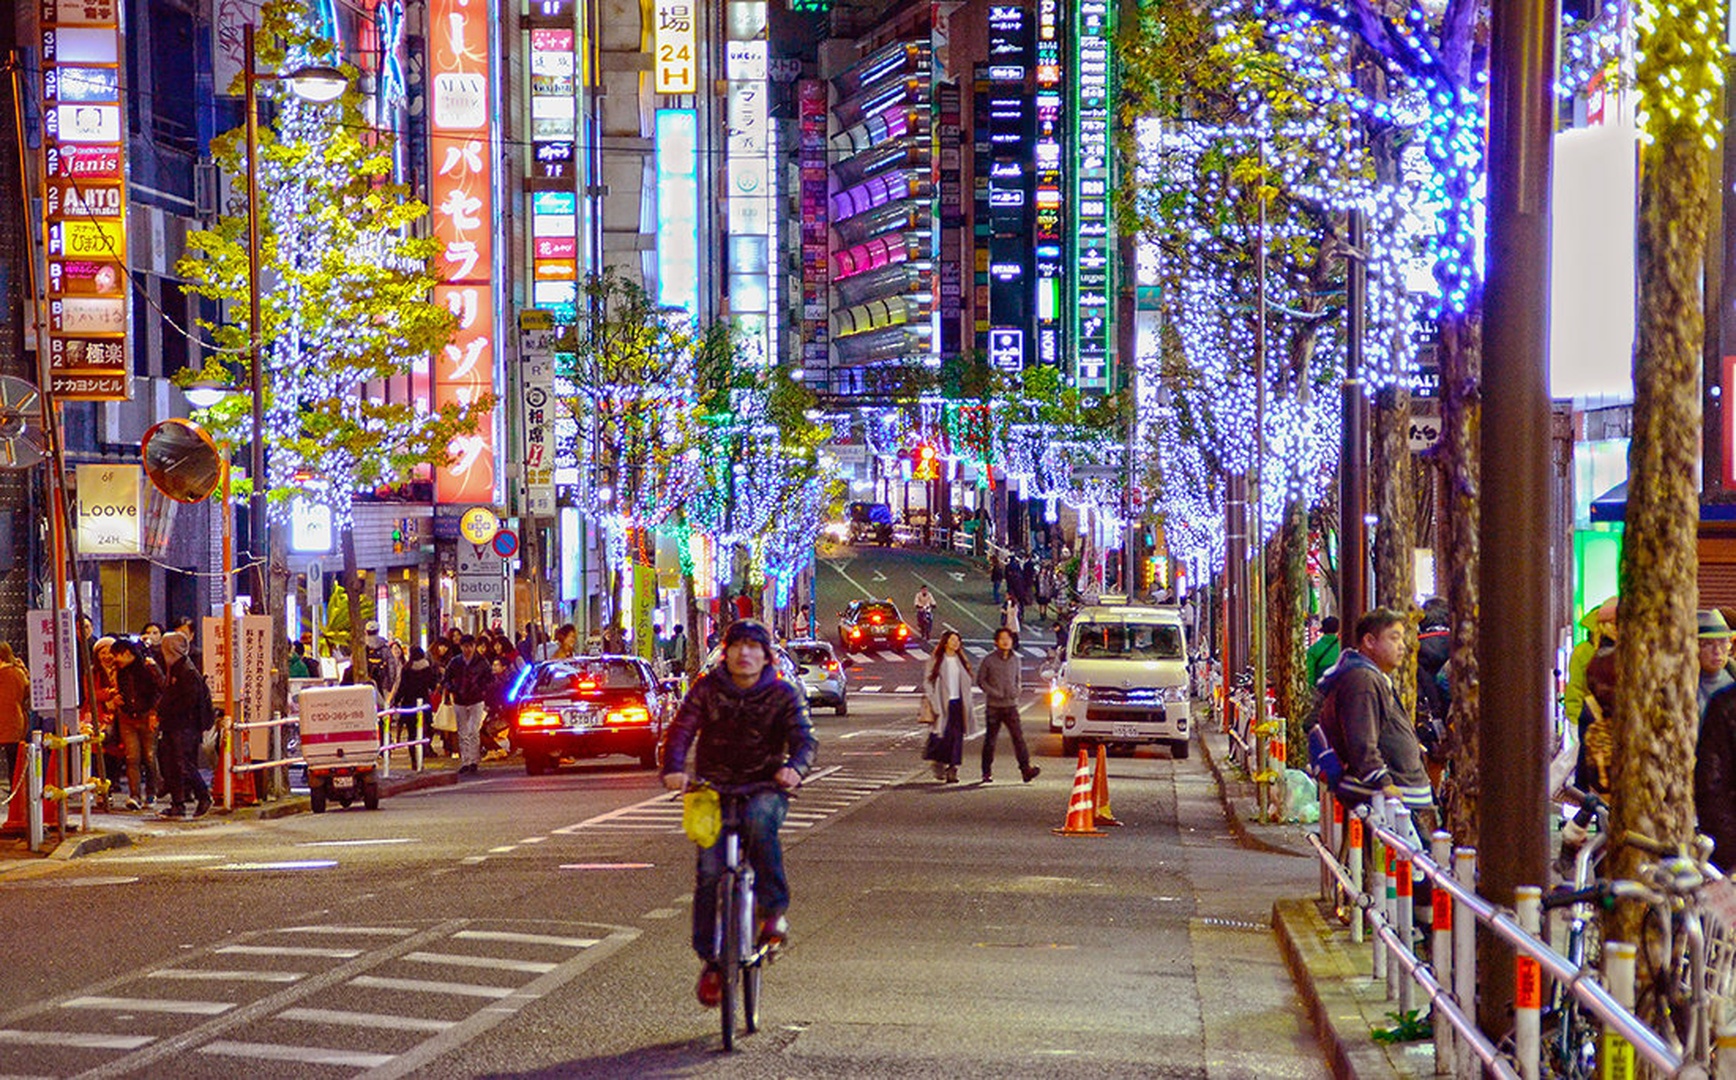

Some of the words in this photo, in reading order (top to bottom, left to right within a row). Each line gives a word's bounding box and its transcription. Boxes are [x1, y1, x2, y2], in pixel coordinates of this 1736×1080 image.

[48, 149, 58, 176] 2F
[61, 154, 117, 177] Janis
[49, 187, 58, 214] 2F
[51, 225, 60, 254] 1F
[50, 263, 62, 291] B1
[52, 302, 62, 328] B1
[53, 340, 63, 367] B2
[86, 343, 123, 364] 極楽
[53, 380, 123, 392] ナカヨシビル
[80, 500, 137, 516] Loove
[460, 582, 499, 592] baton
